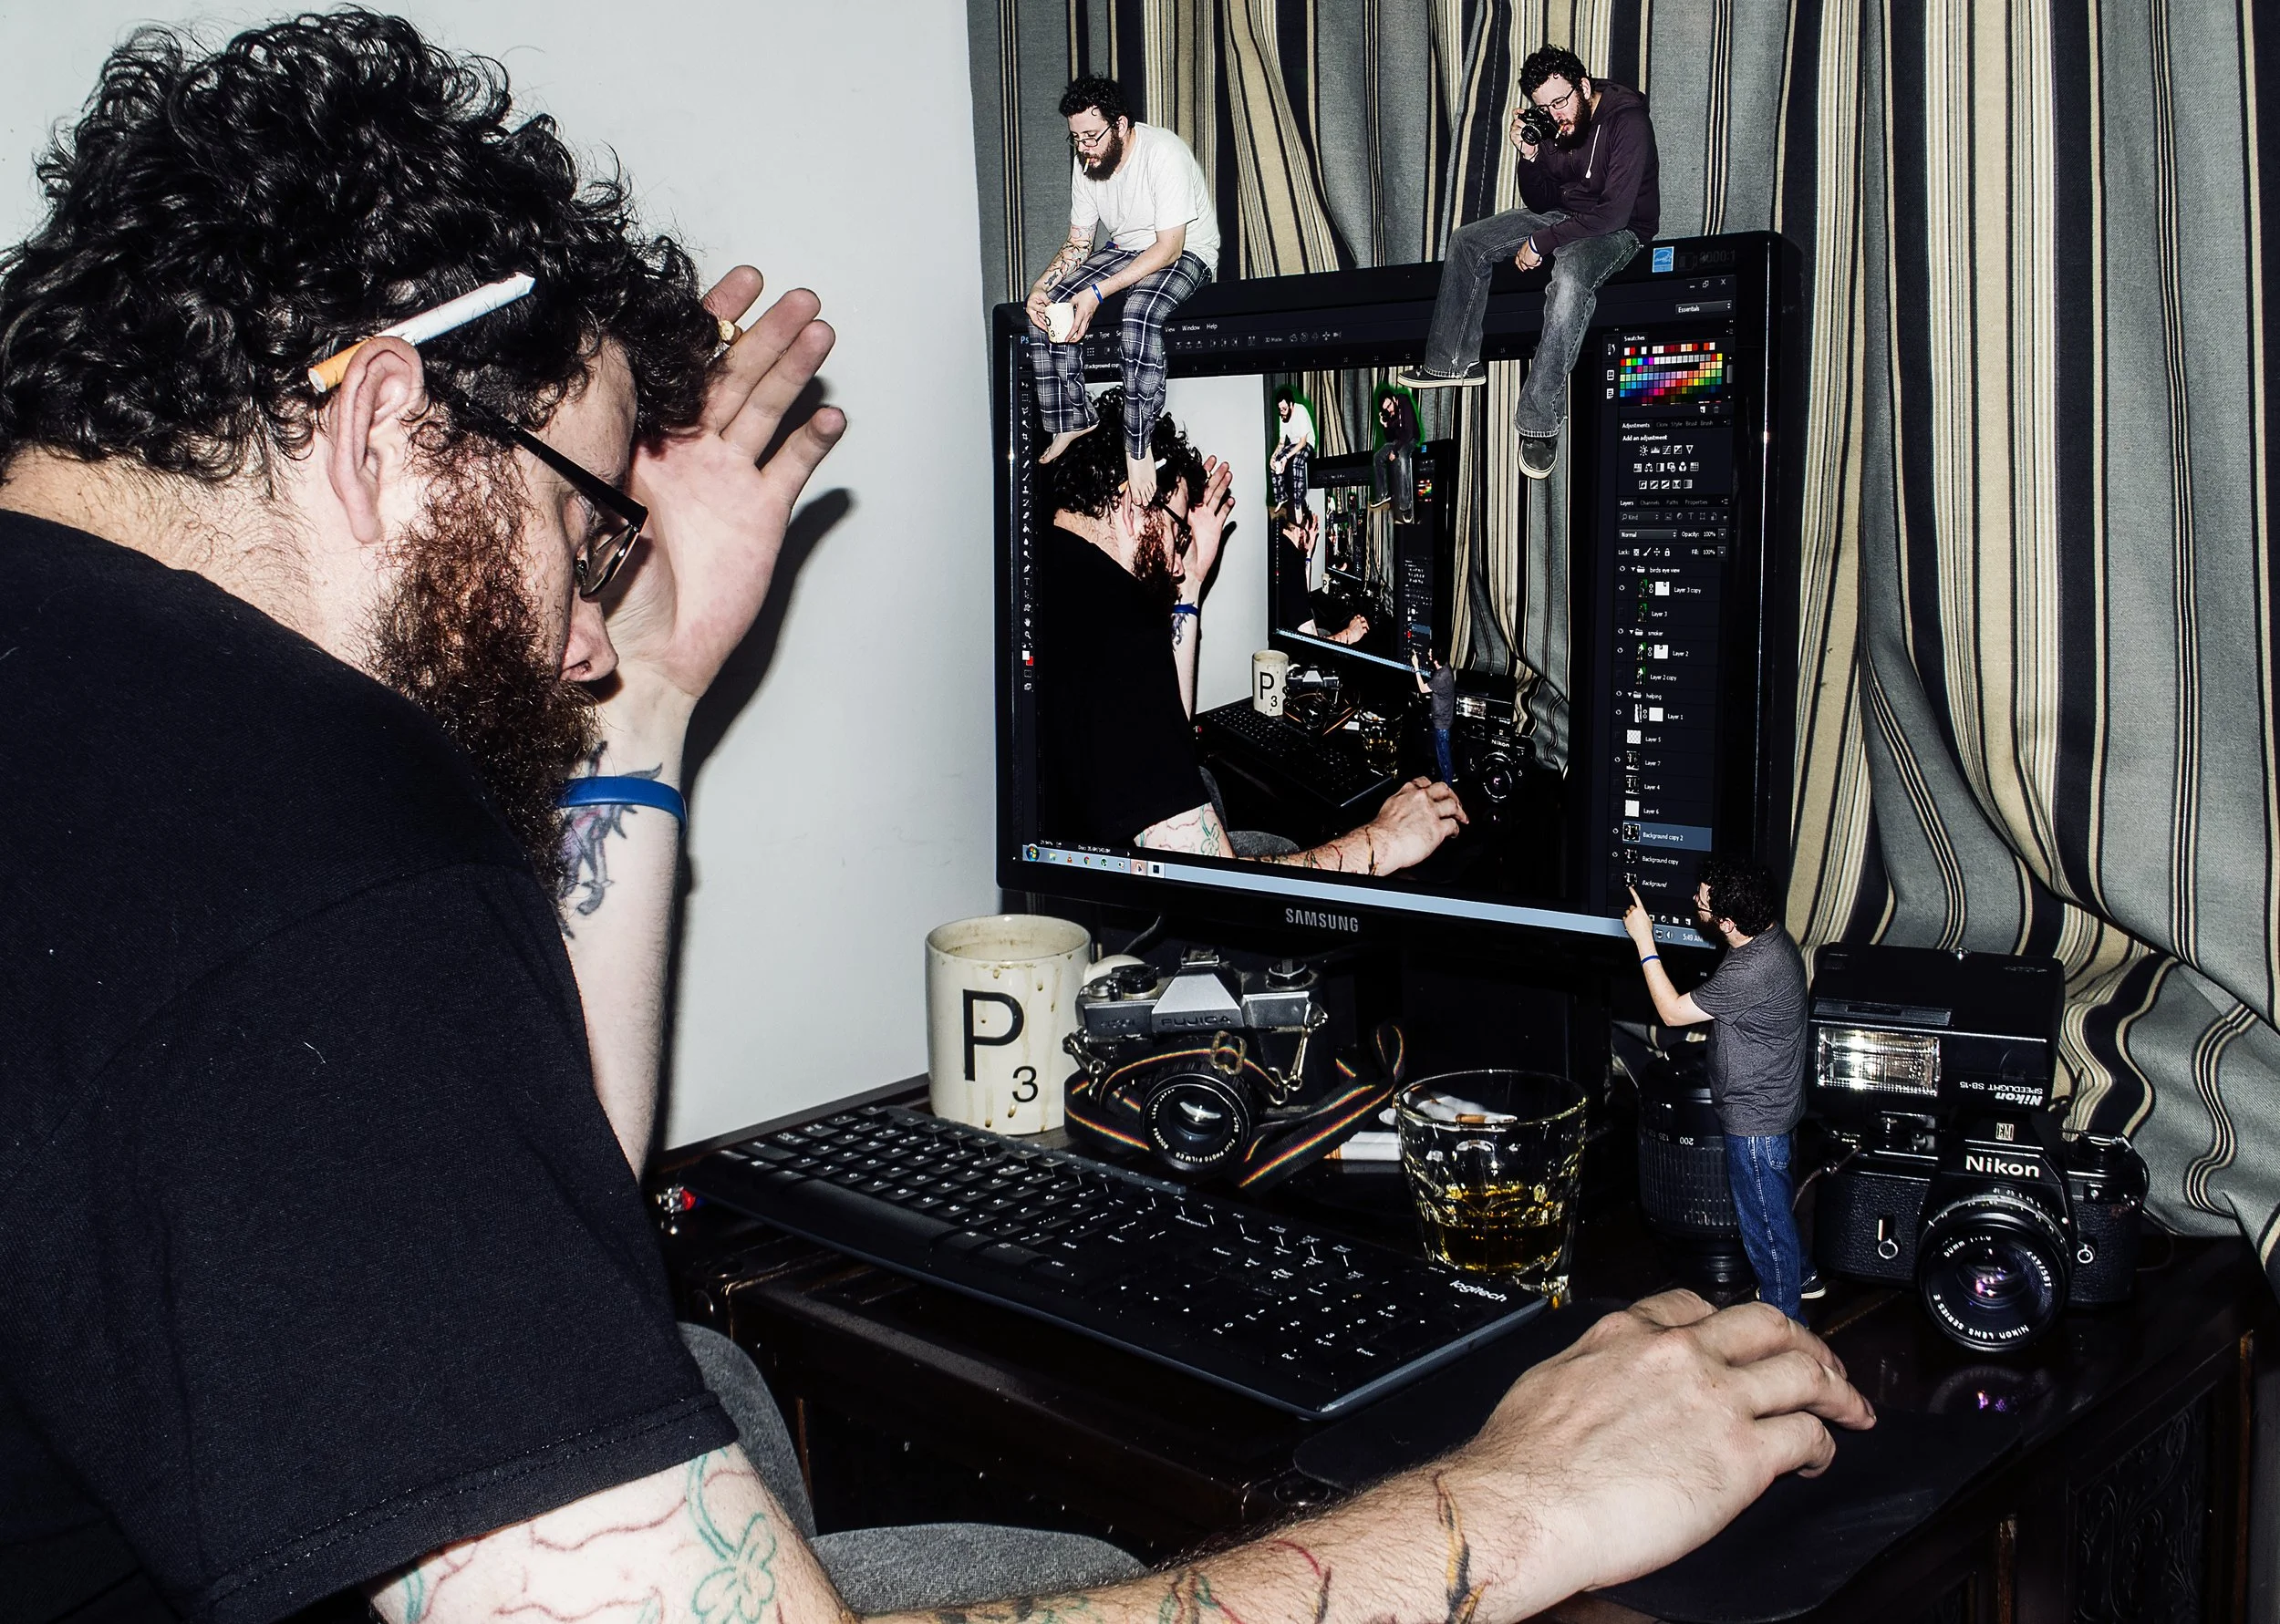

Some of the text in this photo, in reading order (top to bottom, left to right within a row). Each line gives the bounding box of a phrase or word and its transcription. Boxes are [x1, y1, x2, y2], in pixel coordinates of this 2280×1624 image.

[1021, 336, 1029, 344] Ps
[1099, 331, 1110, 340] Type
[1260, 671, 1277, 707] P 3
[1491, 739, 1510, 748] Nikon
[1643, 832, 1668, 840] Background
[1642, 856, 1668, 865] Background
[1642, 880, 1667, 888] Background
[1286, 908, 1359, 933] SAMSUNG
[1161, 1015, 1232, 1027] FUJICA
[963, 988, 1039, 1102] P 3
[1987, 1084, 2043, 1094] SPEEDLIGHT
[1995, 1092, 2043, 1106] Nikon
[1997, 1123, 2014, 1140] EM
[1679, 1137, 1694, 1145] 200
[1205, 1151, 1224, 1162] PHOTO
[1965, 1155, 2040, 1178] Nikon
[1449, 1280, 1507, 1302] logitech
[1937, 1303, 1964, 1330] SERIES
[1968, 1328, 1994, 1340] LENS
[1999, 1324, 2030, 1340] NIKON
